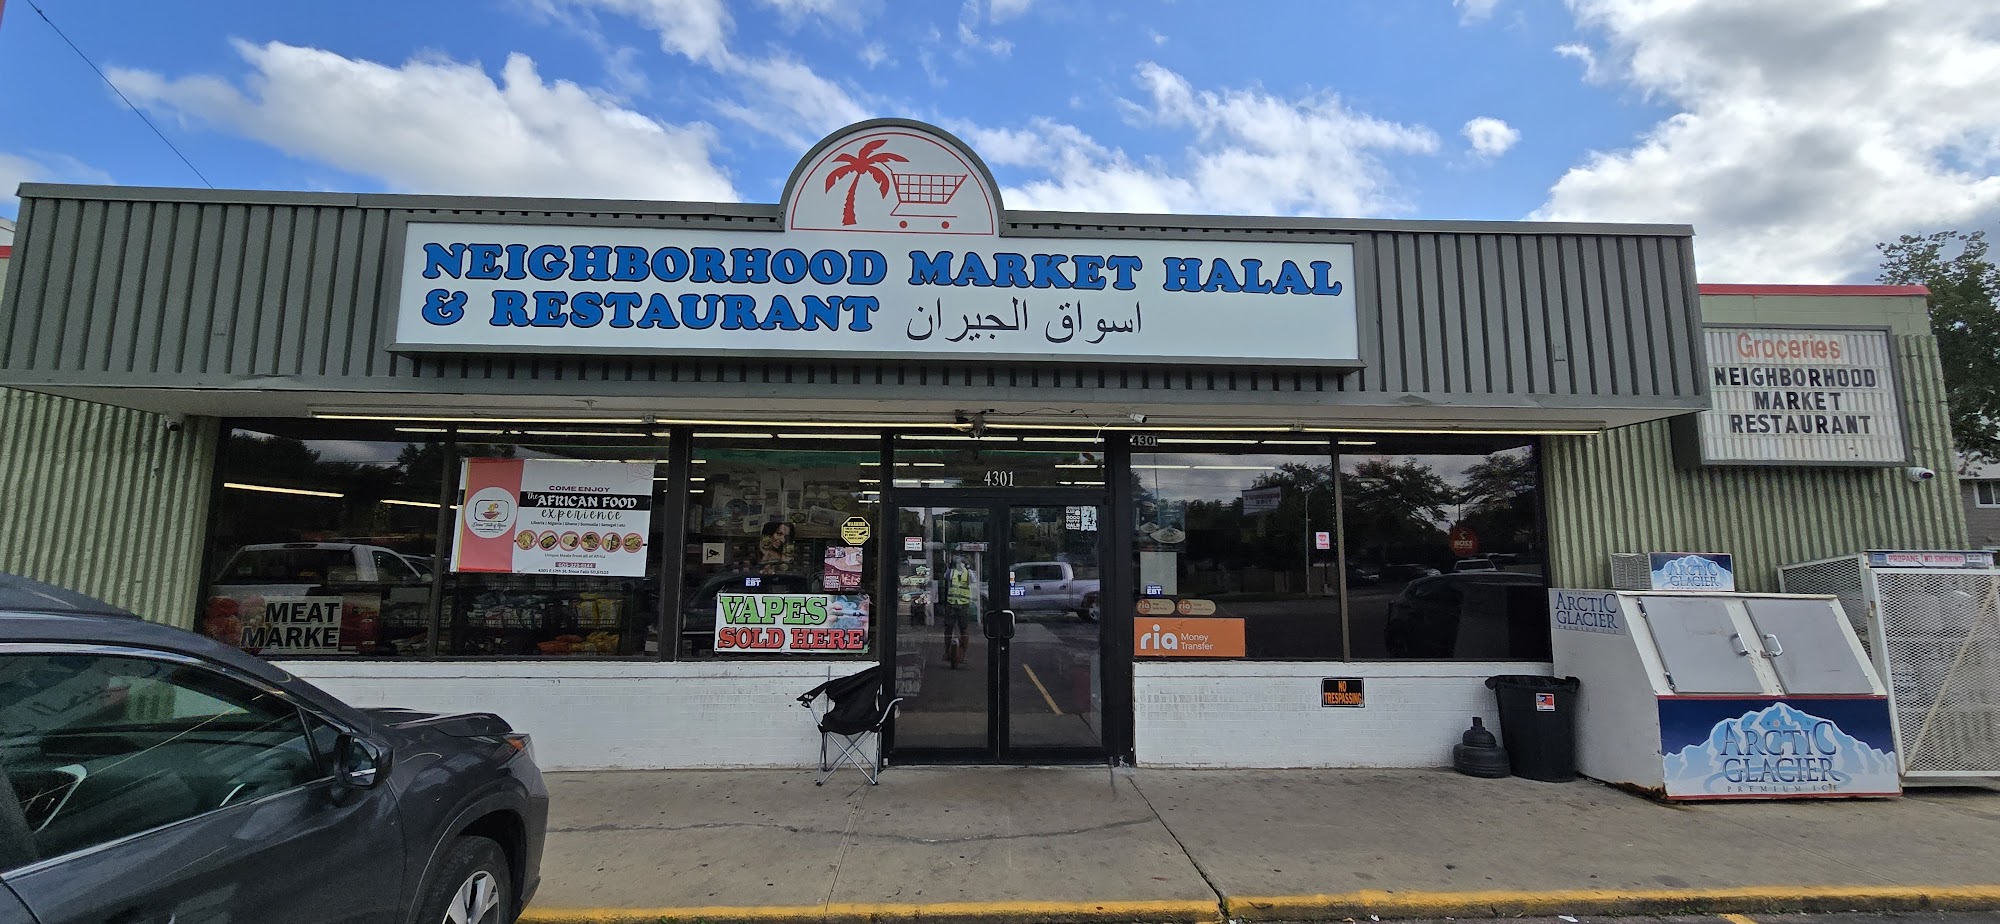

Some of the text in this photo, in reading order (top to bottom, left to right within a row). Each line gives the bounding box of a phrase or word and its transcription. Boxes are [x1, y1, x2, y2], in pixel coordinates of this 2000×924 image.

[422, 243, 1343, 297] NEIGHBORHOOD MARKET HALAL
[421, 289, 880, 333] & RESTAURANT
[906, 297, 1142, 344] اسواق الجيران
[1737, 332, 1841, 360] Groceries
[1714, 367, 1876, 388] NEIGHBORHOOD
[1755, 391, 1842, 411] MARKET
[1731, 414, 1871, 435] RESTAURANT
[1132, 436, 1158, 445] 4301
[984, 471, 1015, 487] 4301
[536, 494, 599, 508] AFRICAN
[602, 496, 638, 509] FOOD
[541, 508, 622, 522] experience
[1668, 561, 1717, 576] ARCTIC
[1670, 576, 1719, 587] GLACIER
[719, 596, 828, 625] VAPES
[1555, 592, 1617, 613] ARCTIC
[264, 602, 340, 624] MEAT
[1556, 611, 1618, 629] GLACIER
[718, 628, 865, 650] SOLD HERE
[1140, 623, 1178, 650] ria
[1181, 633, 1208, 642] Money
[1181, 642, 1214, 650] Transfer
[1338, 681, 1347, 692] NO
[1324, 693, 1362, 705] TRESPASSING
[1720, 721, 1837, 756] ARCTIC
[1723, 758, 1840, 783] GLACIER
[1727, 784, 1838, 793] PREMIUM ICE
